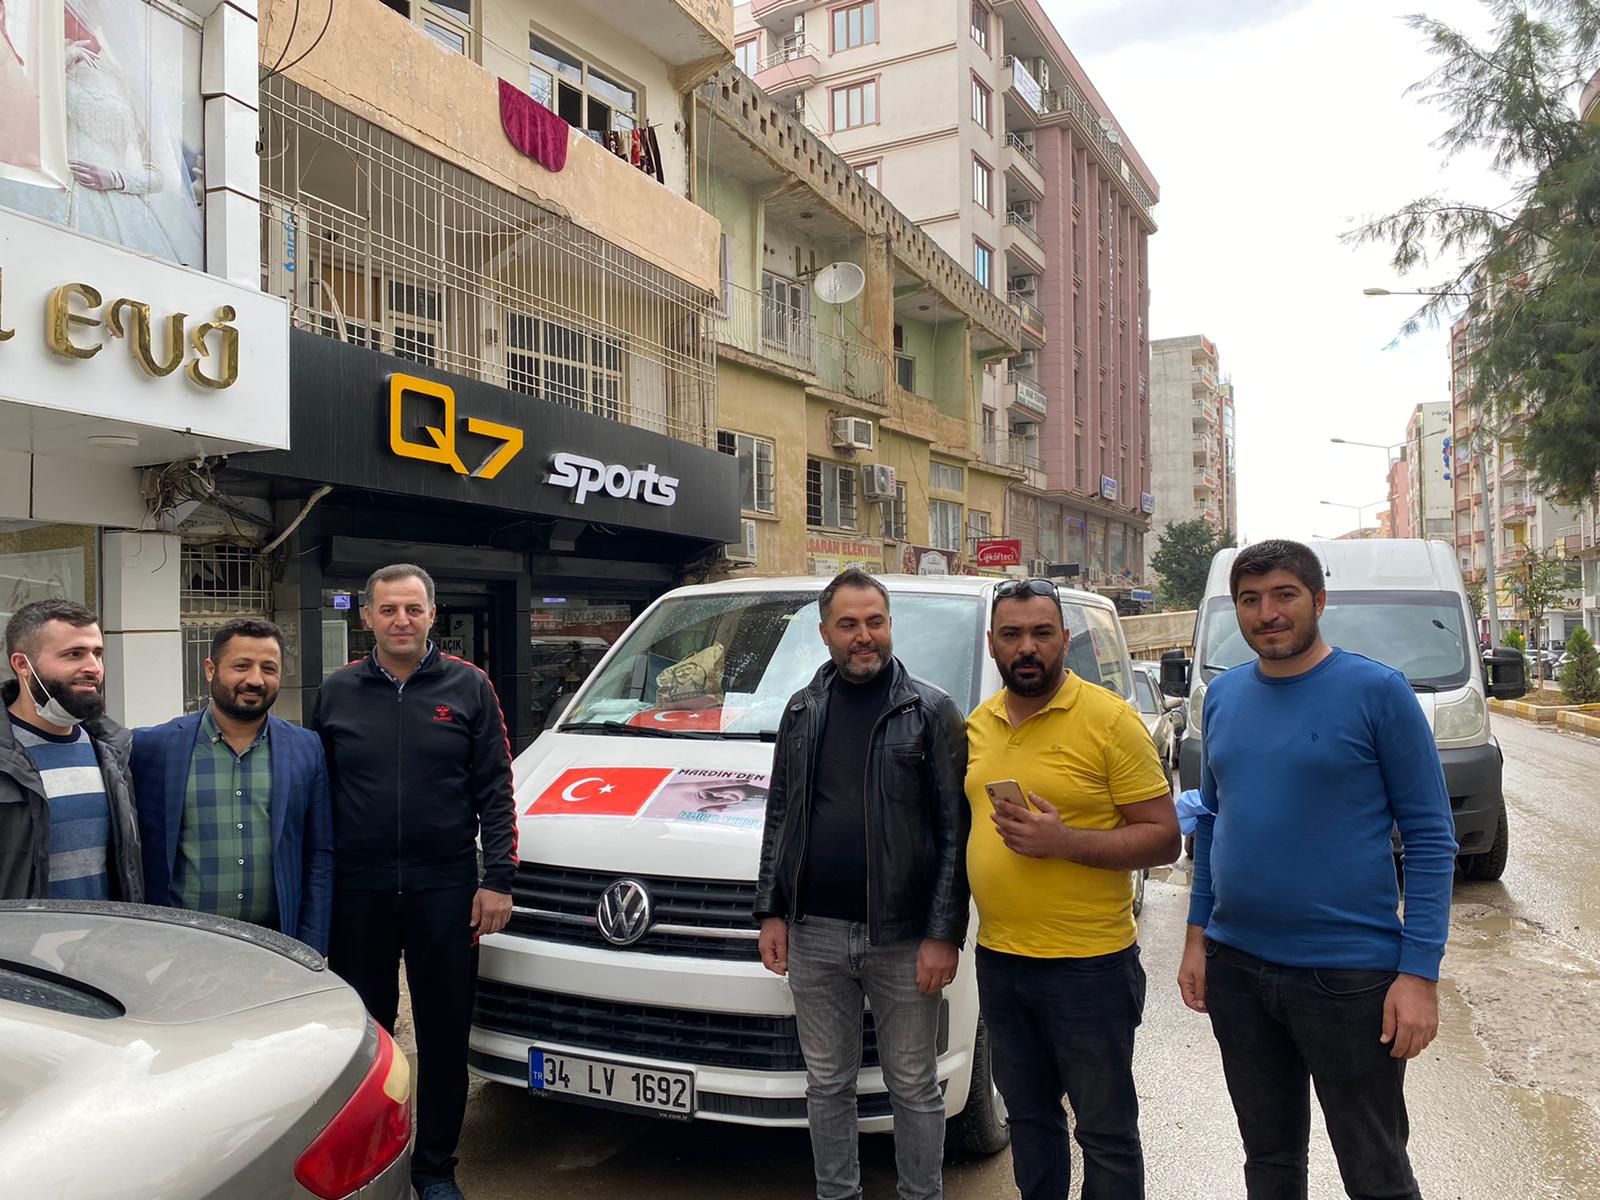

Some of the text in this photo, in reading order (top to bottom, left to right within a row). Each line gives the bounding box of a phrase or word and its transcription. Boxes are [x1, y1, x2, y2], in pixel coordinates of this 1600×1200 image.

[388, 372, 680, 506] Q7 sports
[678, 769, 765, 781] MARDİN'DEN
[532, 1070, 543, 1081] TR
[544, 1057, 687, 1108] 34 LV 1692
